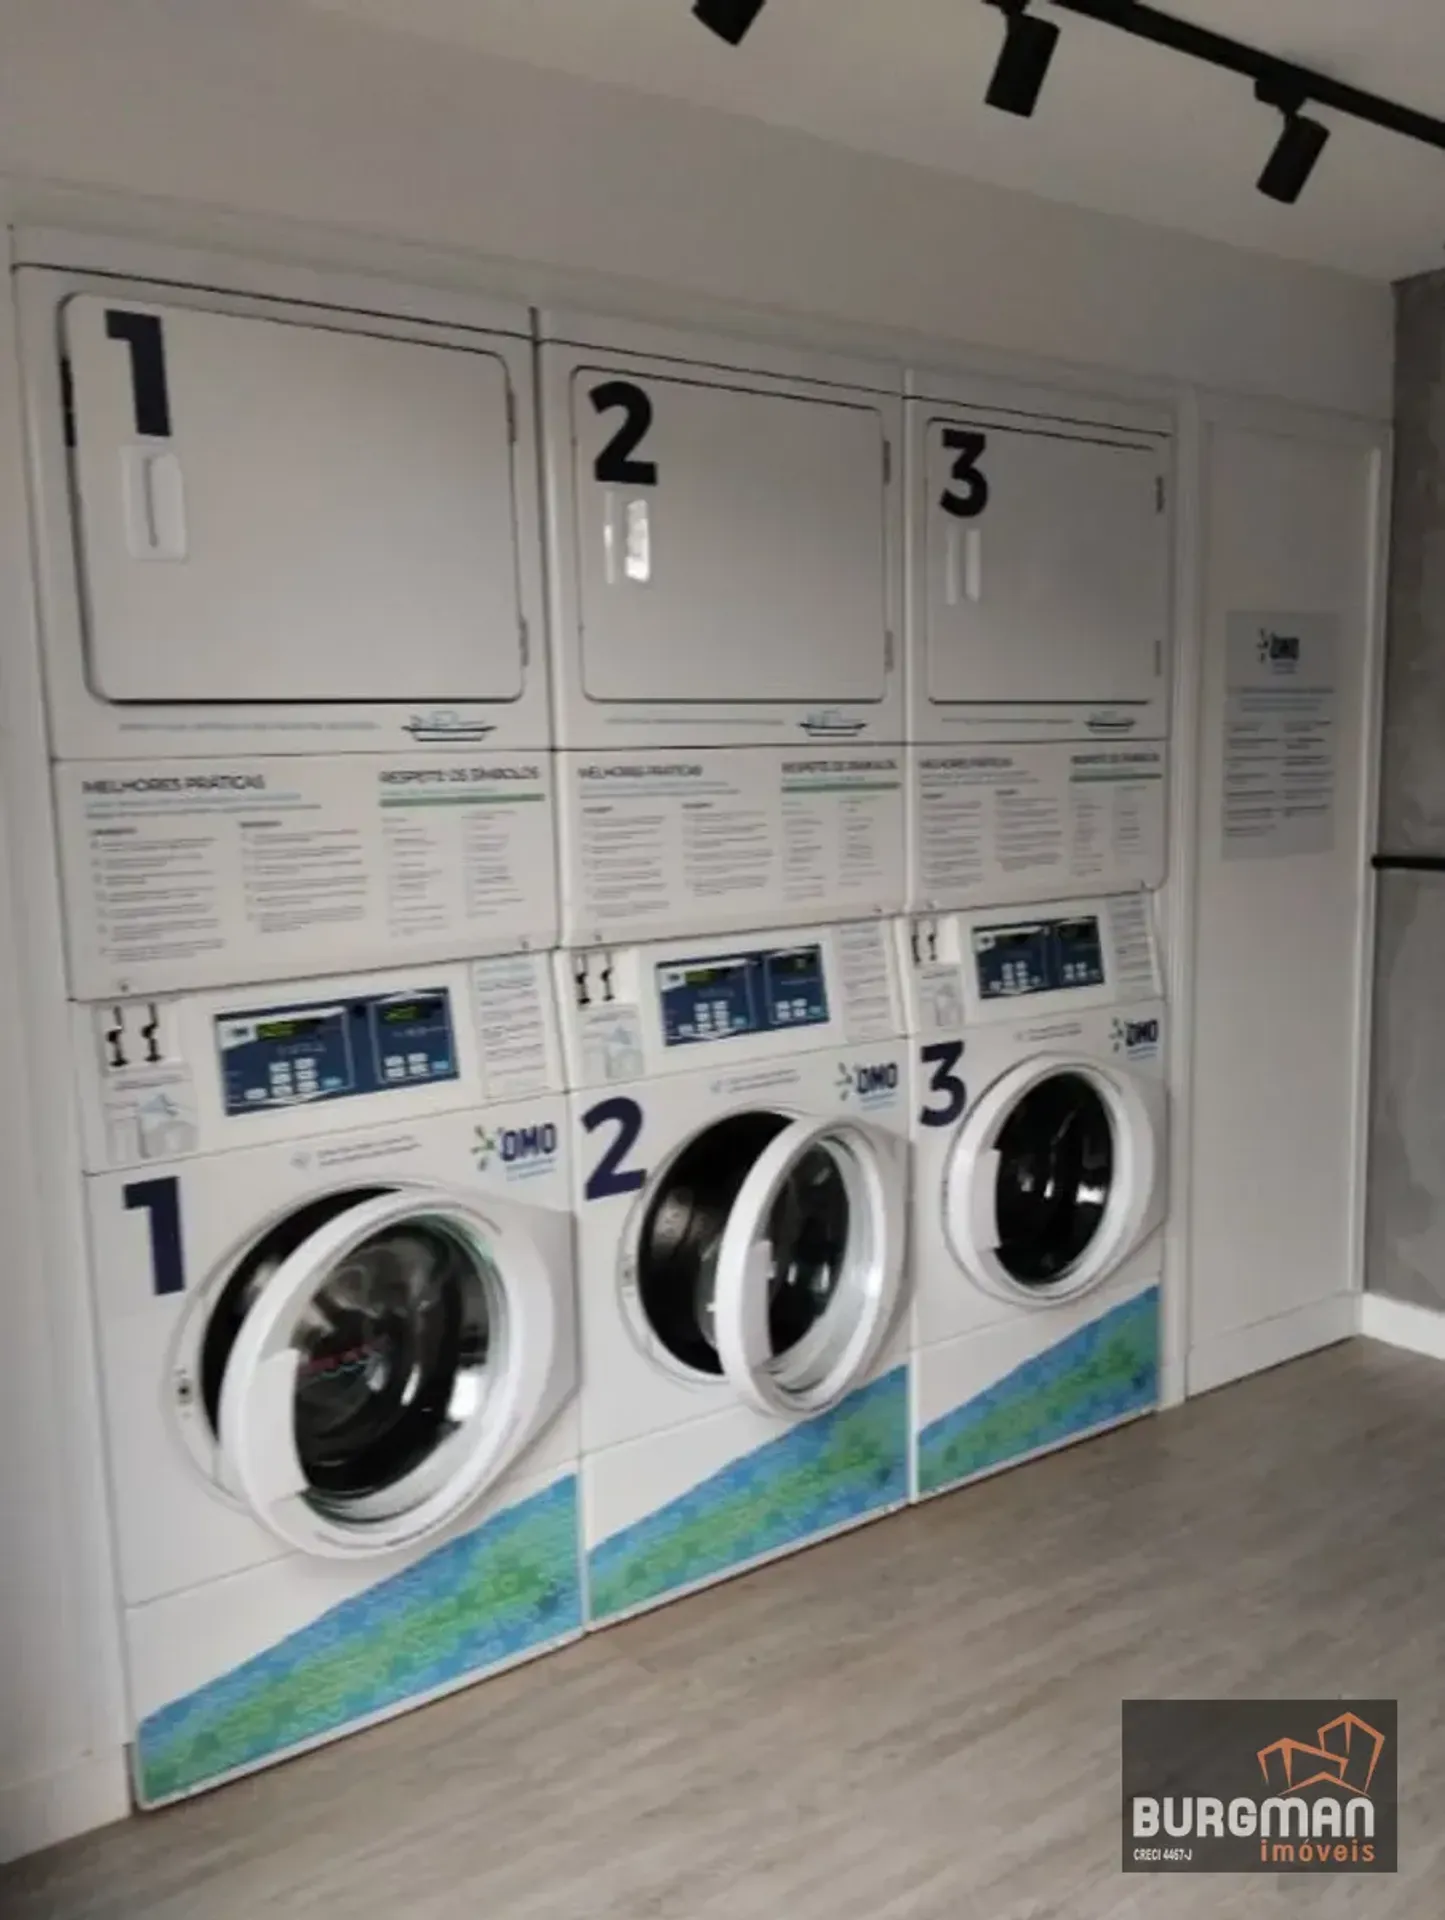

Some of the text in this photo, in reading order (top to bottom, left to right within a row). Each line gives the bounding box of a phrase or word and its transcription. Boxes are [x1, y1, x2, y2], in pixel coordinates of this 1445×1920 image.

[105, 309, 172, 437] 1
[588, 381, 658, 486] 2
[939, 429, 989, 518] 3
[857, 1061, 898, 1094] OMO
[918, 1040, 967, 1127] 3
[499, 1122, 557, 1161] OMO
[581, 1096, 648, 1201] 2
[122, 1175, 186, 1296] 1
